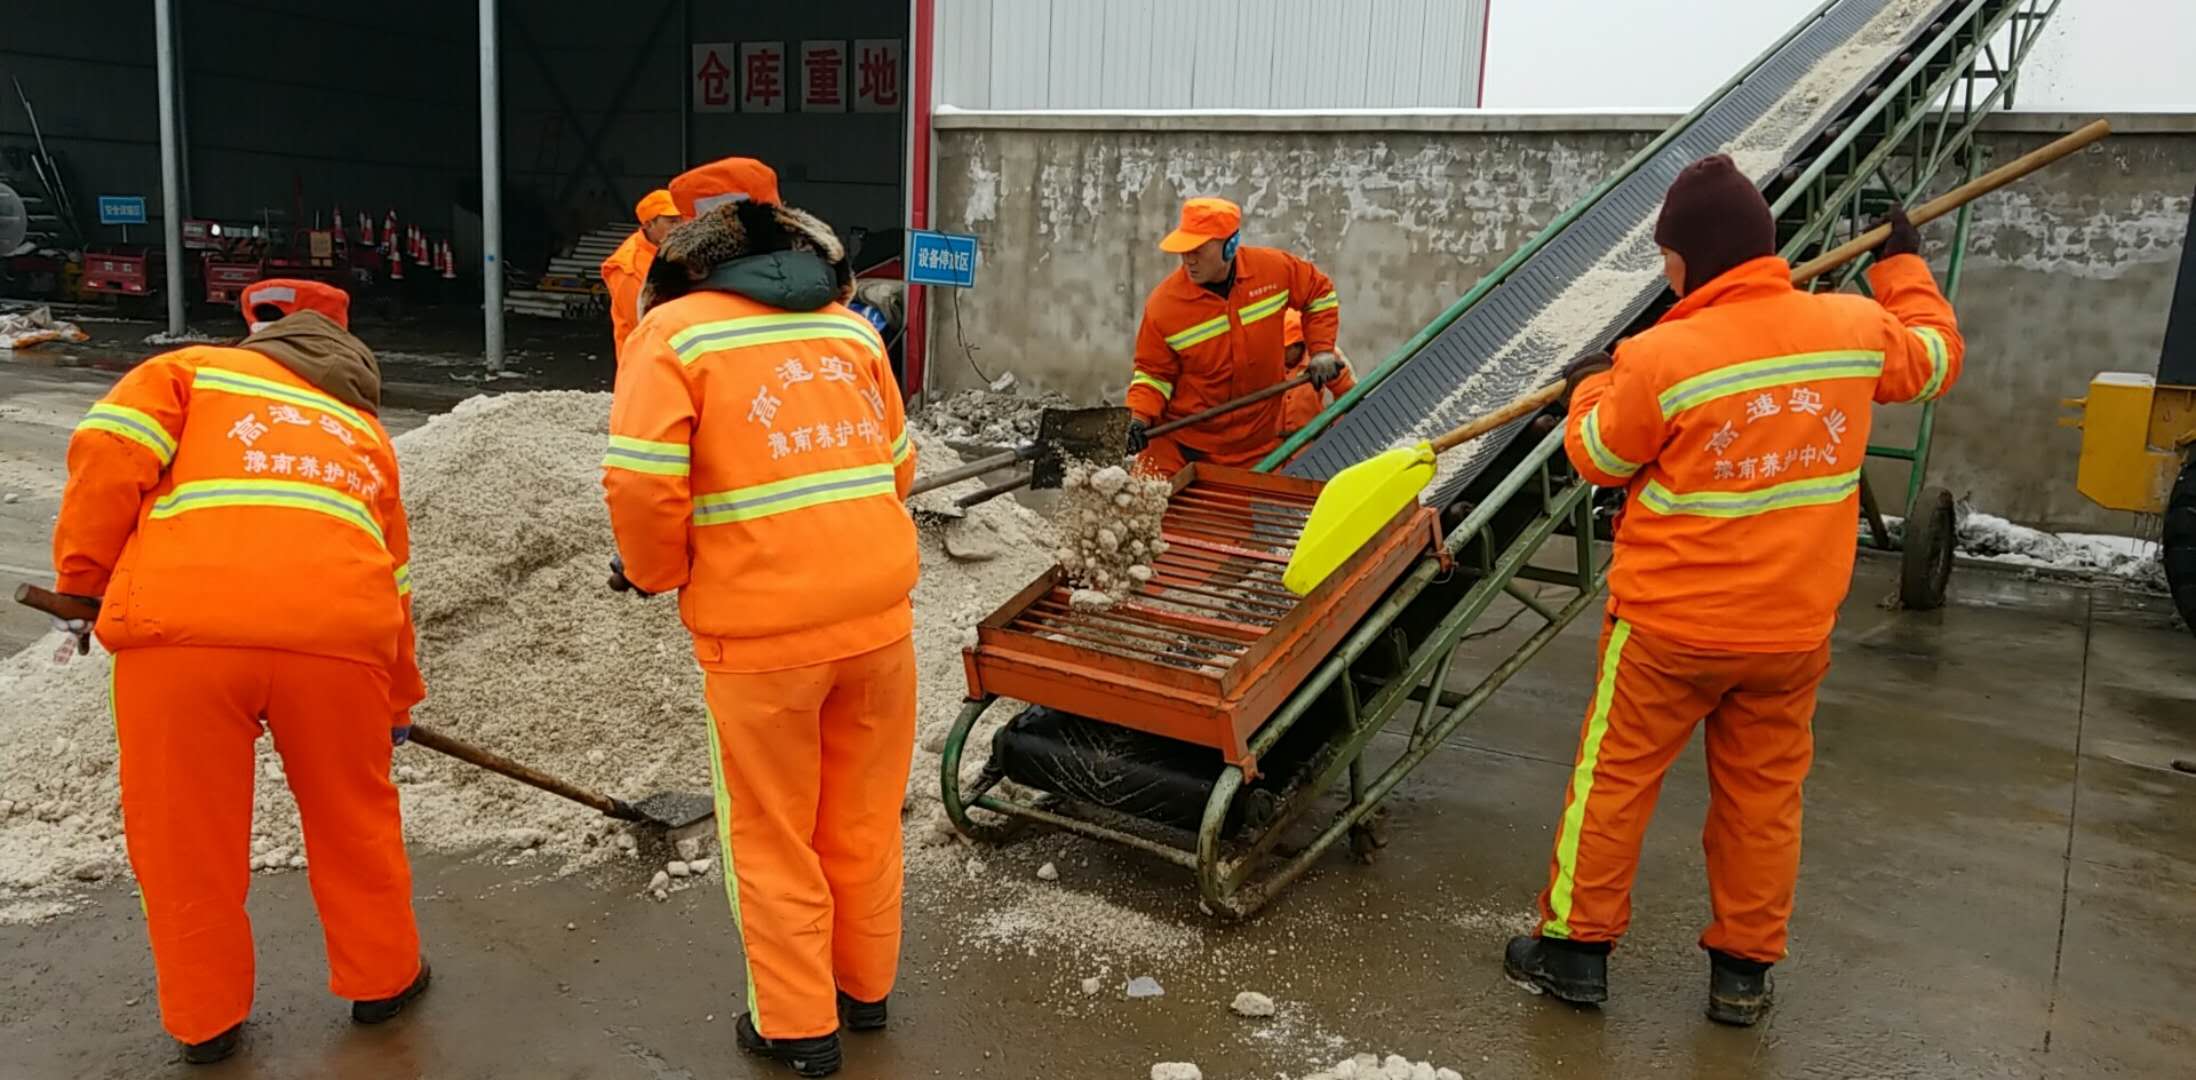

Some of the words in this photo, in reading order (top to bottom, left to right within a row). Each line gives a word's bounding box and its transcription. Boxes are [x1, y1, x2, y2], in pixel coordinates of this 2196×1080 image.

[697, 47, 898, 106] 仓库重地
[747, 355, 885, 428] 高速实业
[1703, 387, 1847, 456] 高速实业
